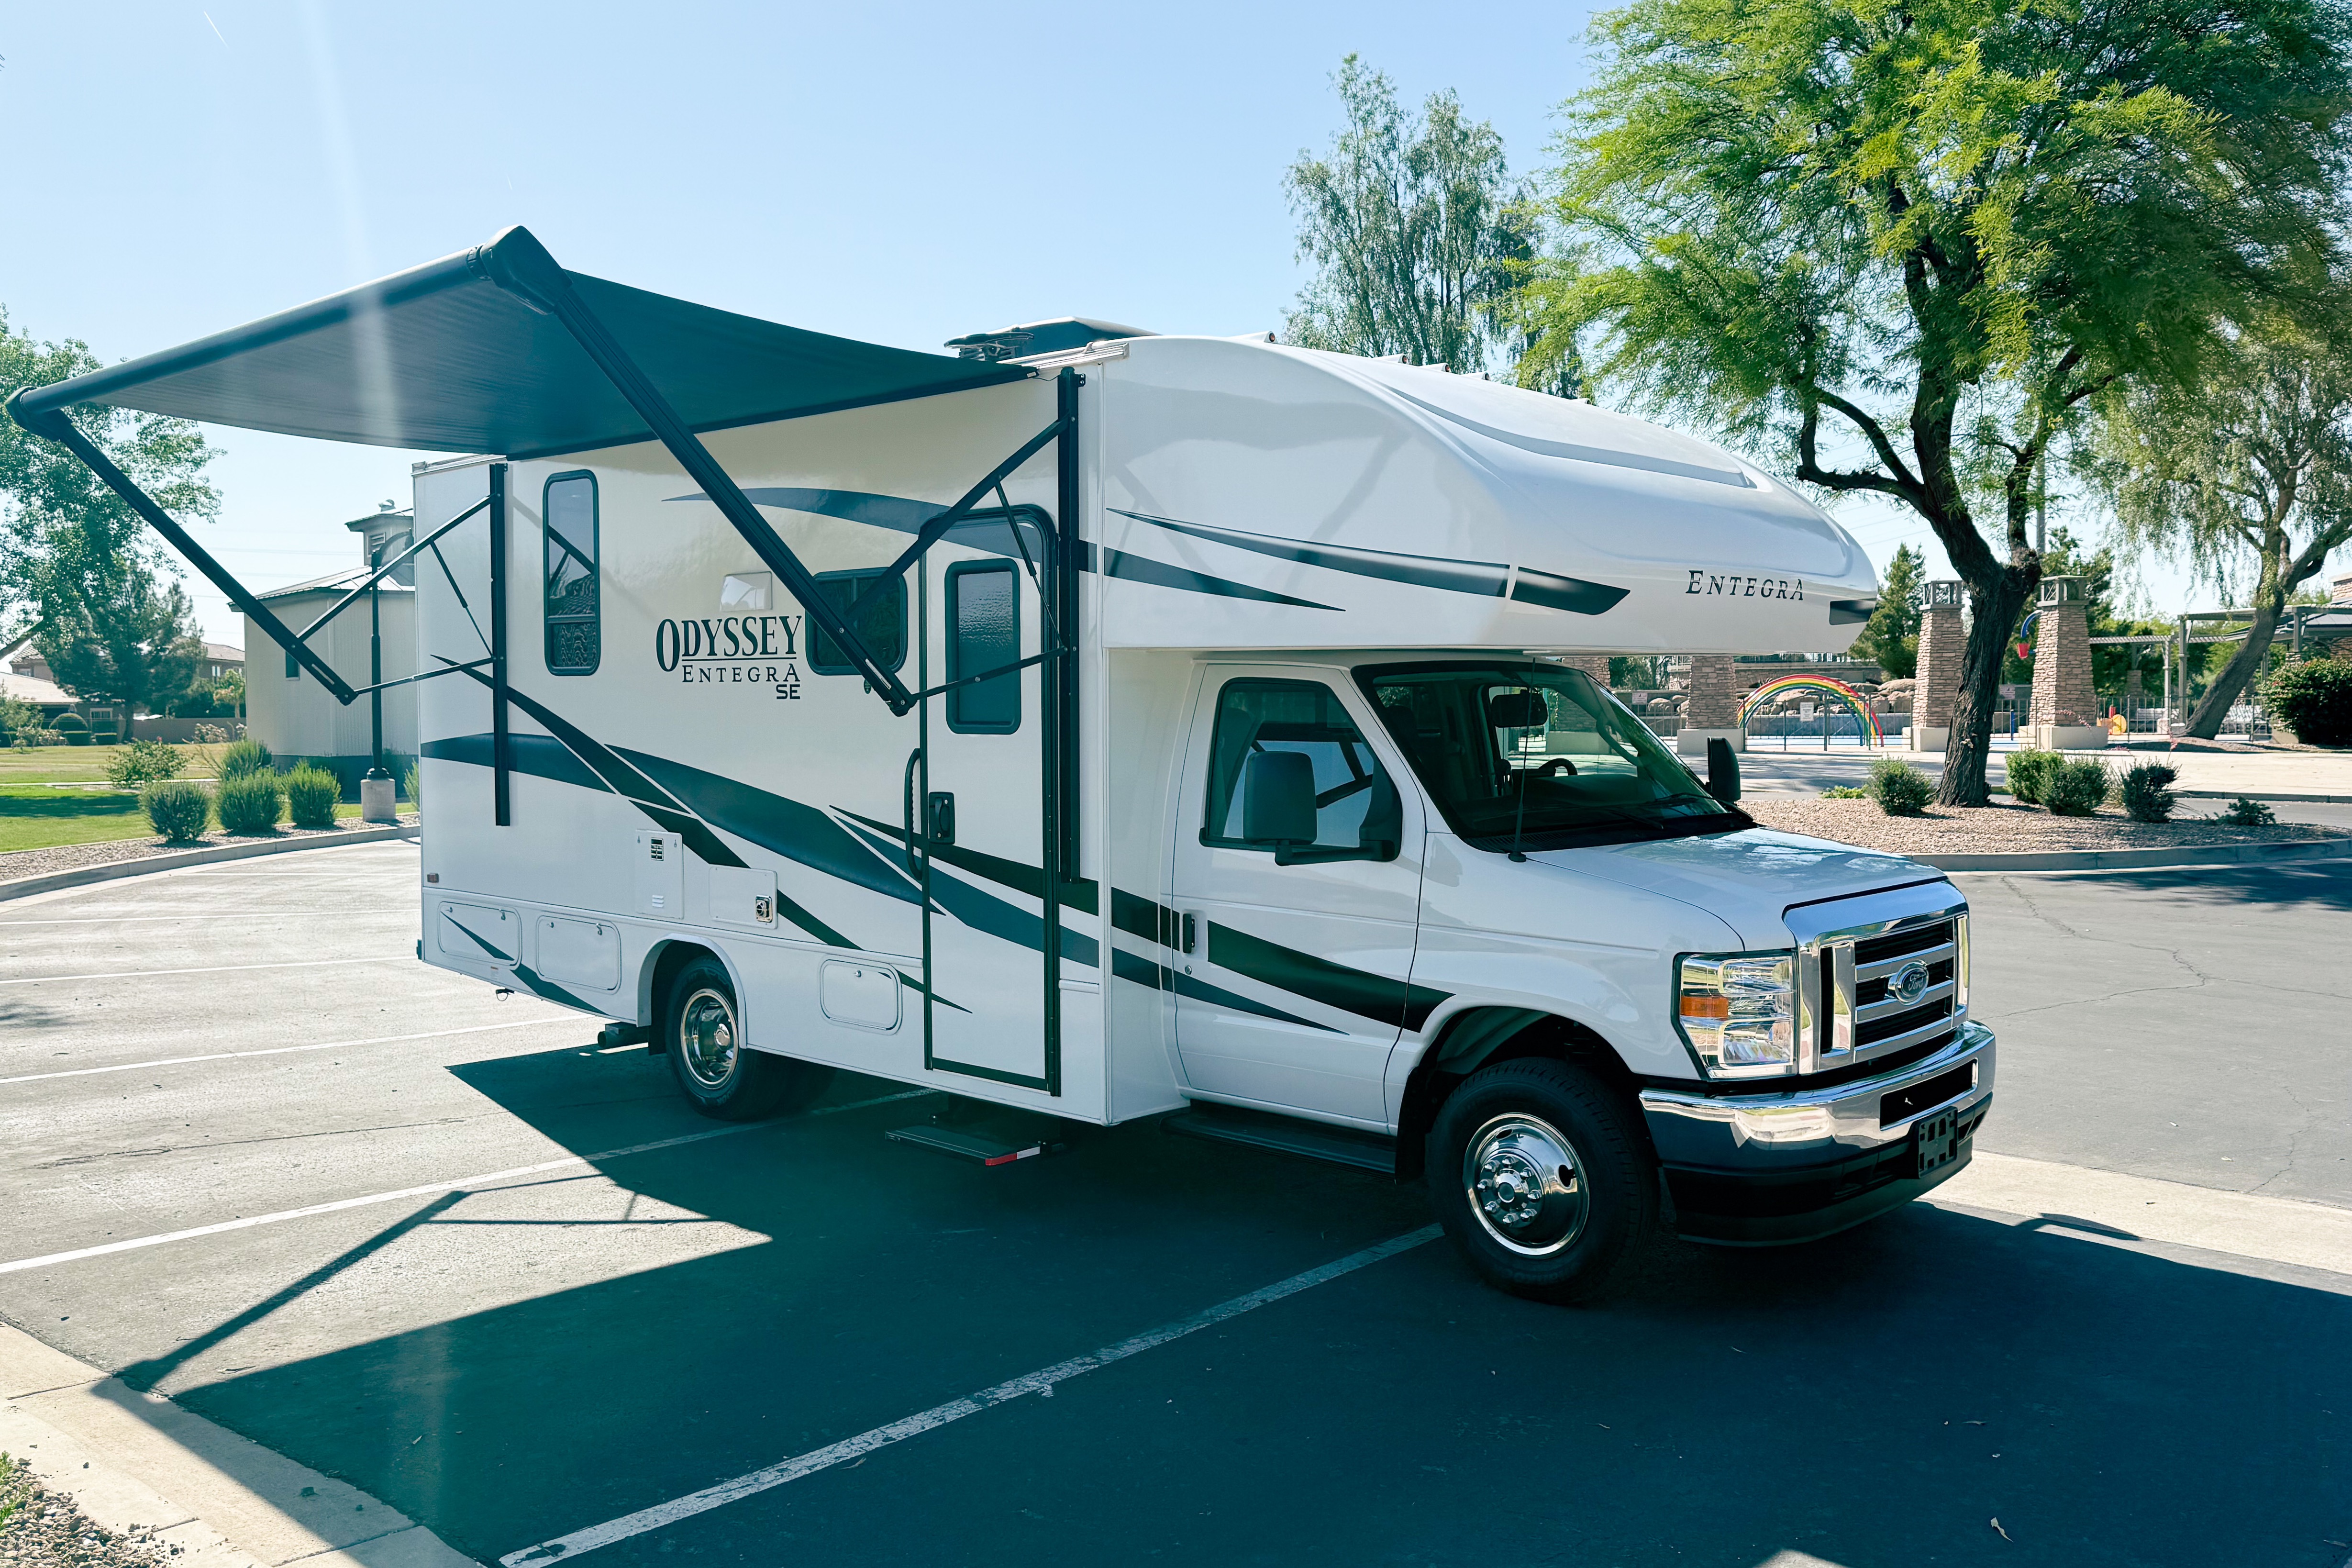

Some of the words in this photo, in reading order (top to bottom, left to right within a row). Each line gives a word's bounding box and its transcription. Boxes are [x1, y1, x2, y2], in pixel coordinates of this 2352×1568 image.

[1686, 570, 1803, 600] ENTEGRA
[656, 615, 802, 672] ODYSSEY
[682, 663, 800, 683] ENTEGRA
[776, 684, 801, 700] SE
[1908, 972, 1926, 991] Ford
